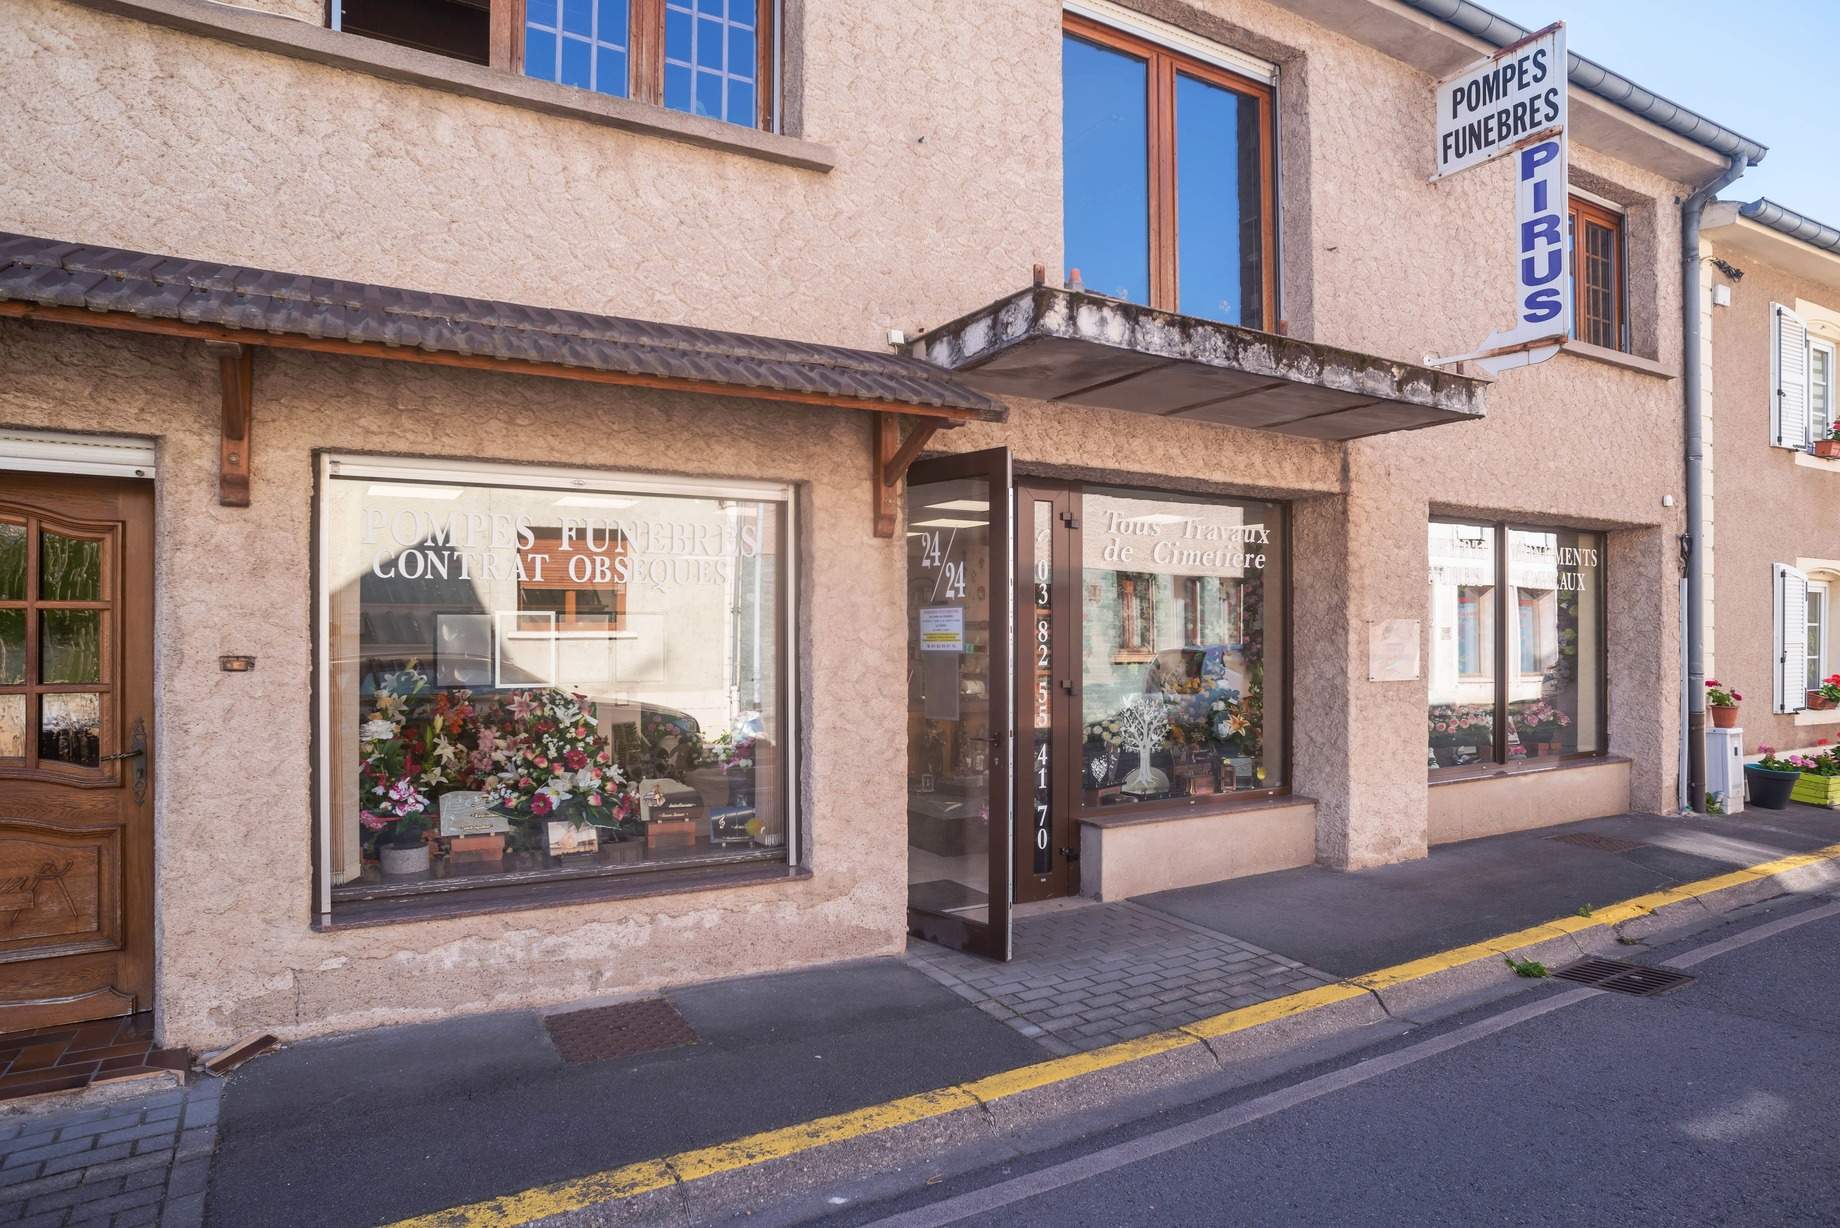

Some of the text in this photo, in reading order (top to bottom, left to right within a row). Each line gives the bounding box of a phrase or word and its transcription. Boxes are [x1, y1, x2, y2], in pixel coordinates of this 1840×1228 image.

[1452, 48, 1548, 120] POMPES
[1442, 87, 1560, 165] FUNEBRES
[1520, 140, 1563, 324] PIRUS
[361, 508, 758, 558] POMPES FUNEBRES
[1104, 510, 1271, 545] Tous Travaux
[373, 548, 730, 593] CONTRAT OBSEQUES
[1104, 538, 1266, 569] de Cimetière
